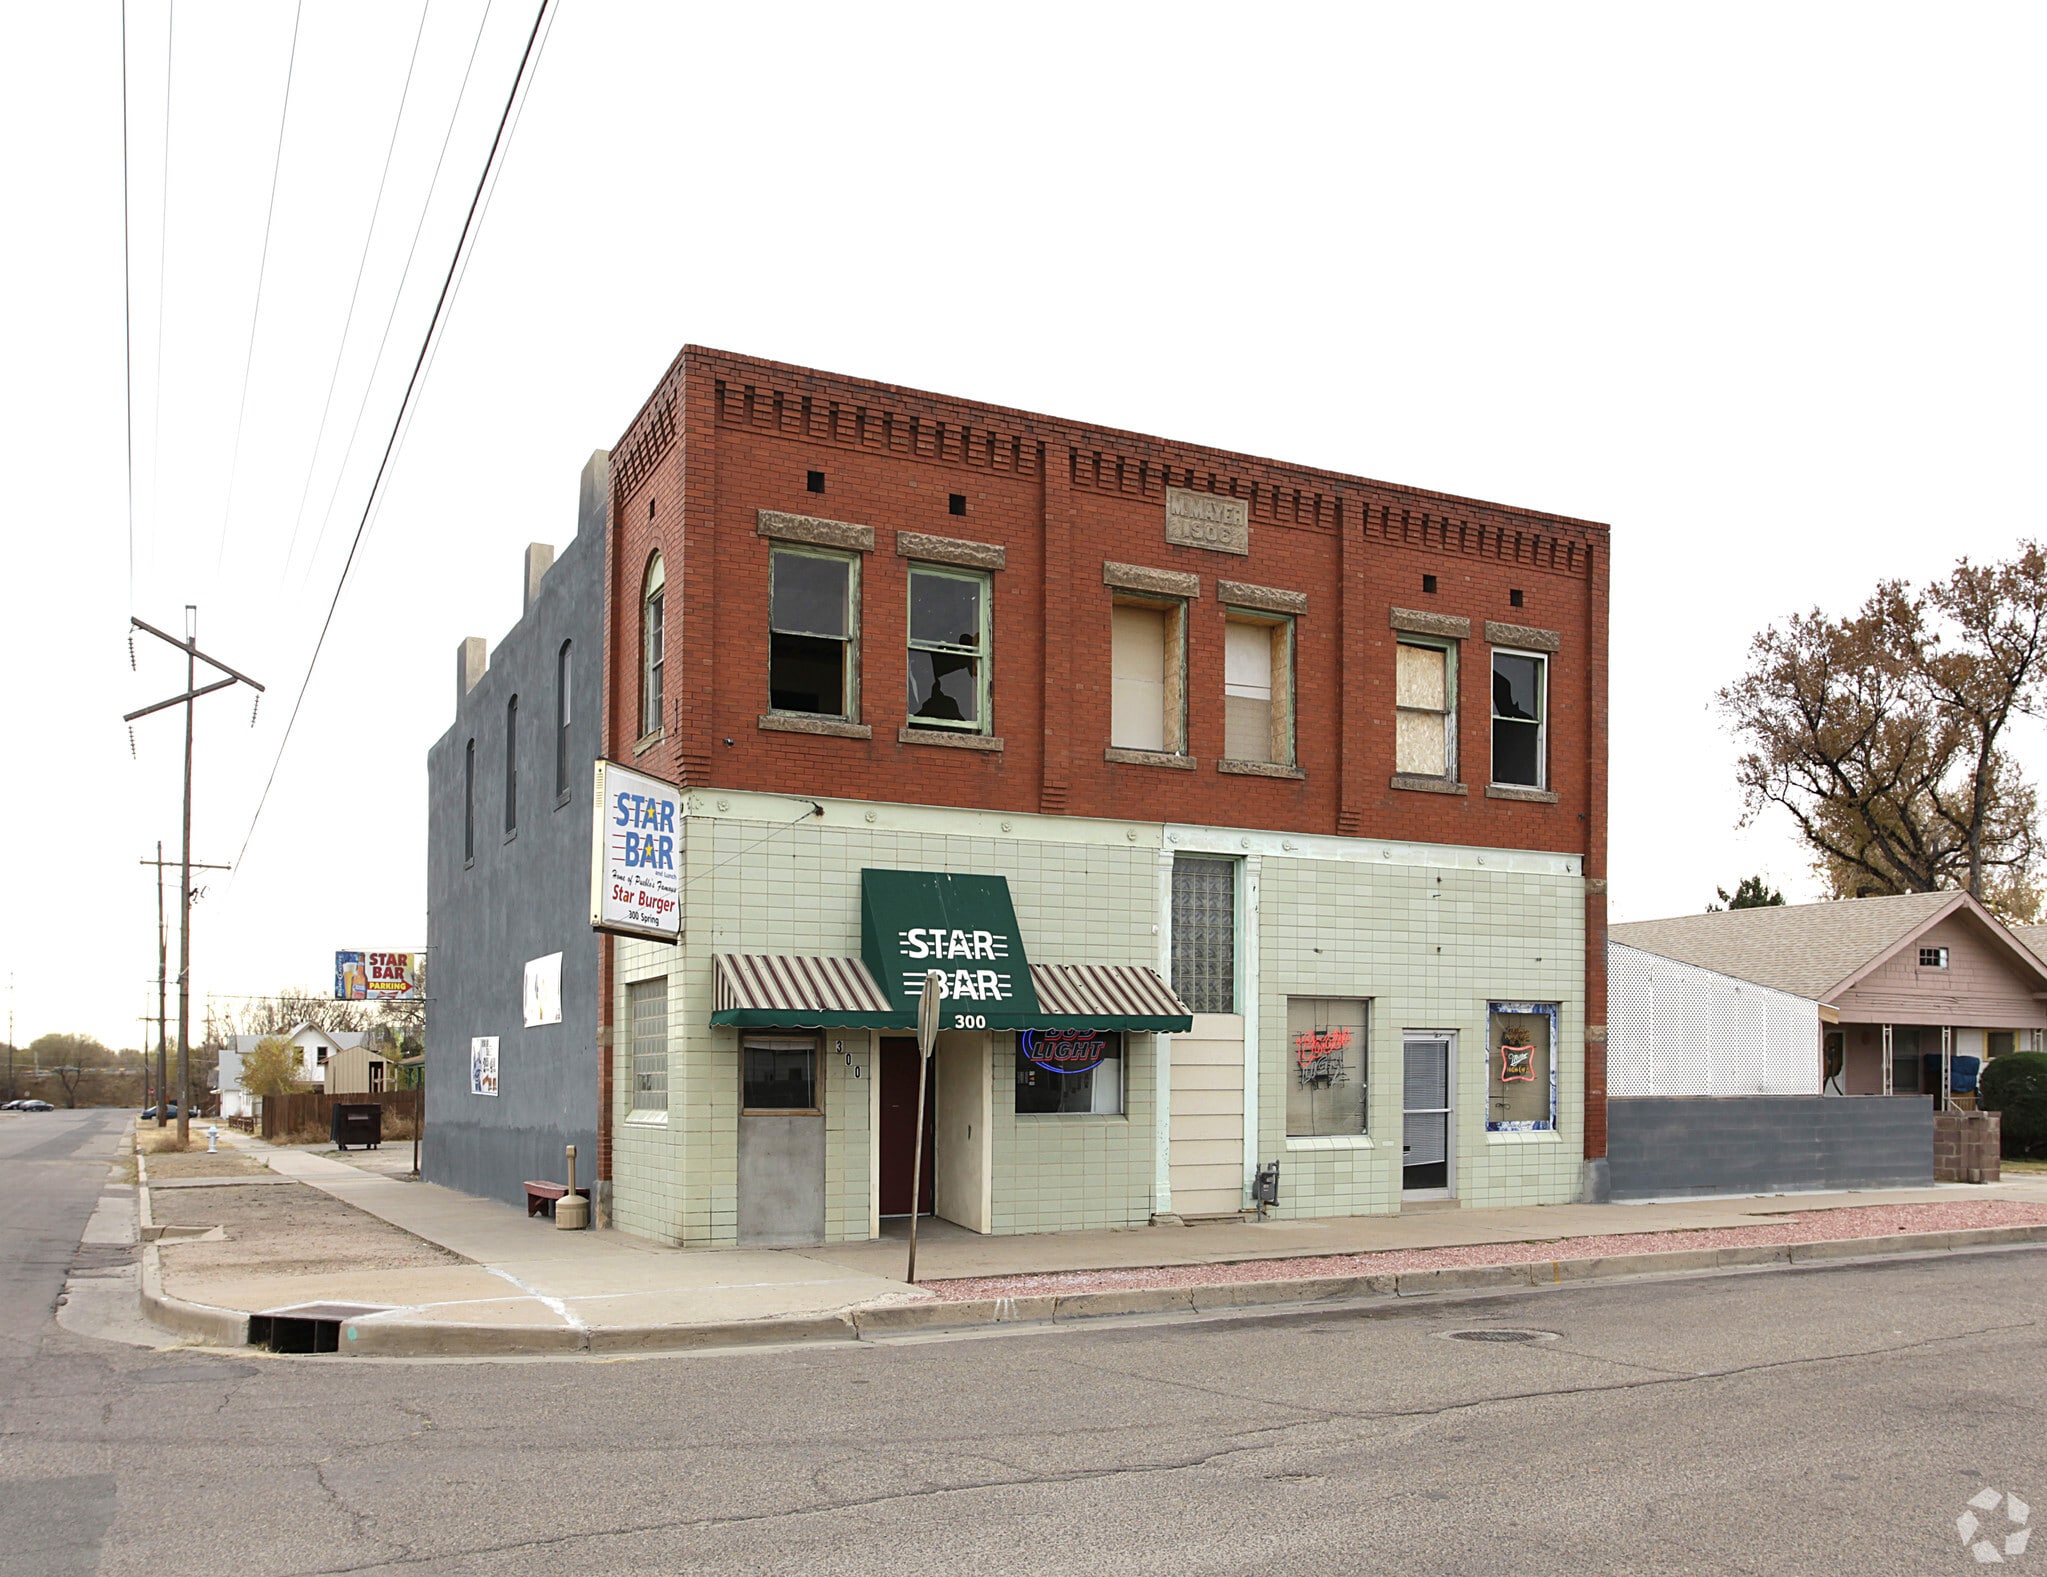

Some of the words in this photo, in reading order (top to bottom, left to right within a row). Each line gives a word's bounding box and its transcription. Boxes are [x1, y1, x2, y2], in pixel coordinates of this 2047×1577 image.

[616, 792, 675, 833] STAR
[625, 831, 674, 870] BAR
[612, 869, 626, 881] Home
[627, 875, 633, 886] of
[657, 880, 677, 893] Famous
[612, 884, 635, 903] Star
[638, 890, 676, 914] Burger
[628, 910, 639, 920] 300
[641, 912, 659, 927] Spring
[907, 928, 996, 960] STAR
[369, 952, 408, 966] STAR
[372, 966, 405, 979] BAR
[369, 982, 407, 990] PARKING
[927, 969, 1003, 1001] BAR
[954, 1015, 986, 1029] 300
[1030, 1041, 1107, 1062] LIGHT
